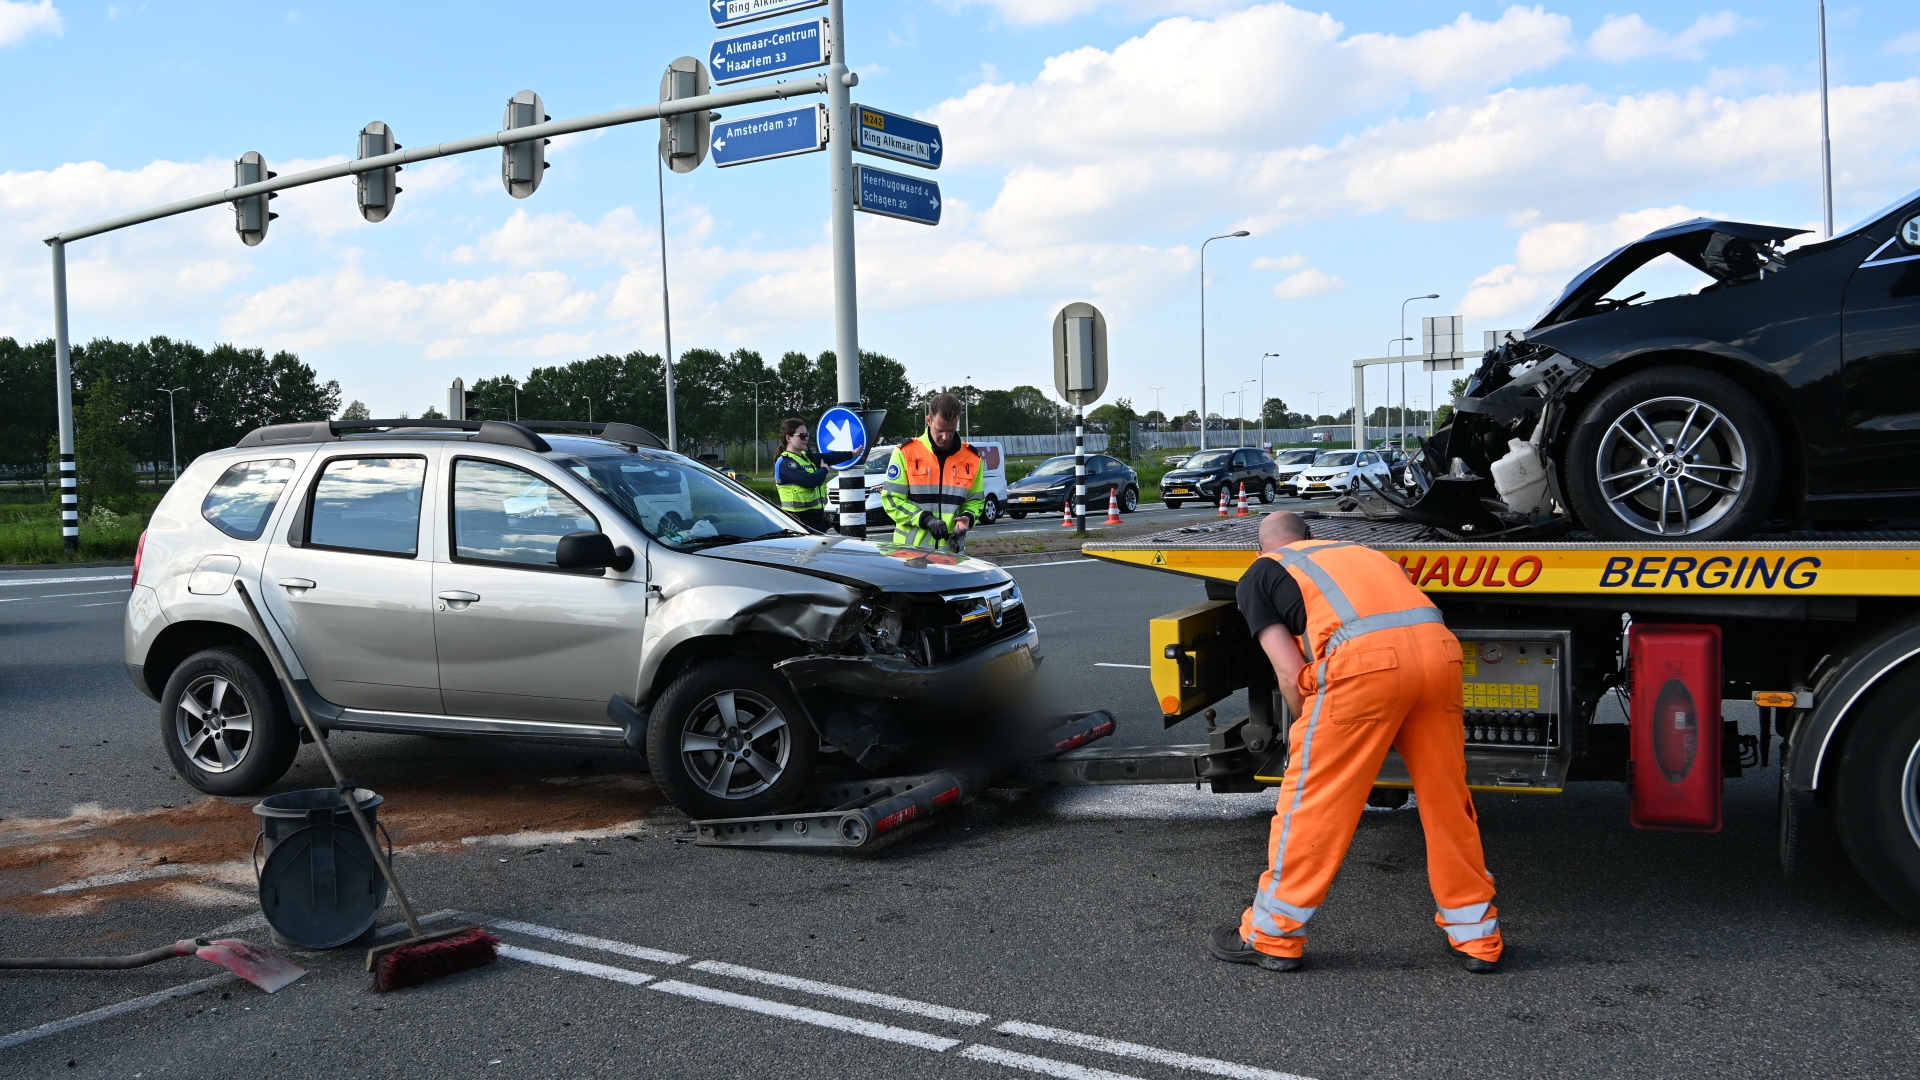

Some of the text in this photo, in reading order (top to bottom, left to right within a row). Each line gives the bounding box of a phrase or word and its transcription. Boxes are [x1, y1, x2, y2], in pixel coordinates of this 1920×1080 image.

[729, 2, 750, 14] Ring
[726, 28, 817, 55] Alkmaar-Centrum
[727, 52, 787, 73] Haarlem 33
[726, 117, 798, 139] Amsterdam 37
[863, 113, 883, 127] N242
[864, 130, 929, 157] Ring Alkmaar (N.)
[863, 173, 922, 196] Heerhugowaard
[863, 190, 908, 209] Schagen 20
[1399, 555, 1822, 589] HAULO BERGING
